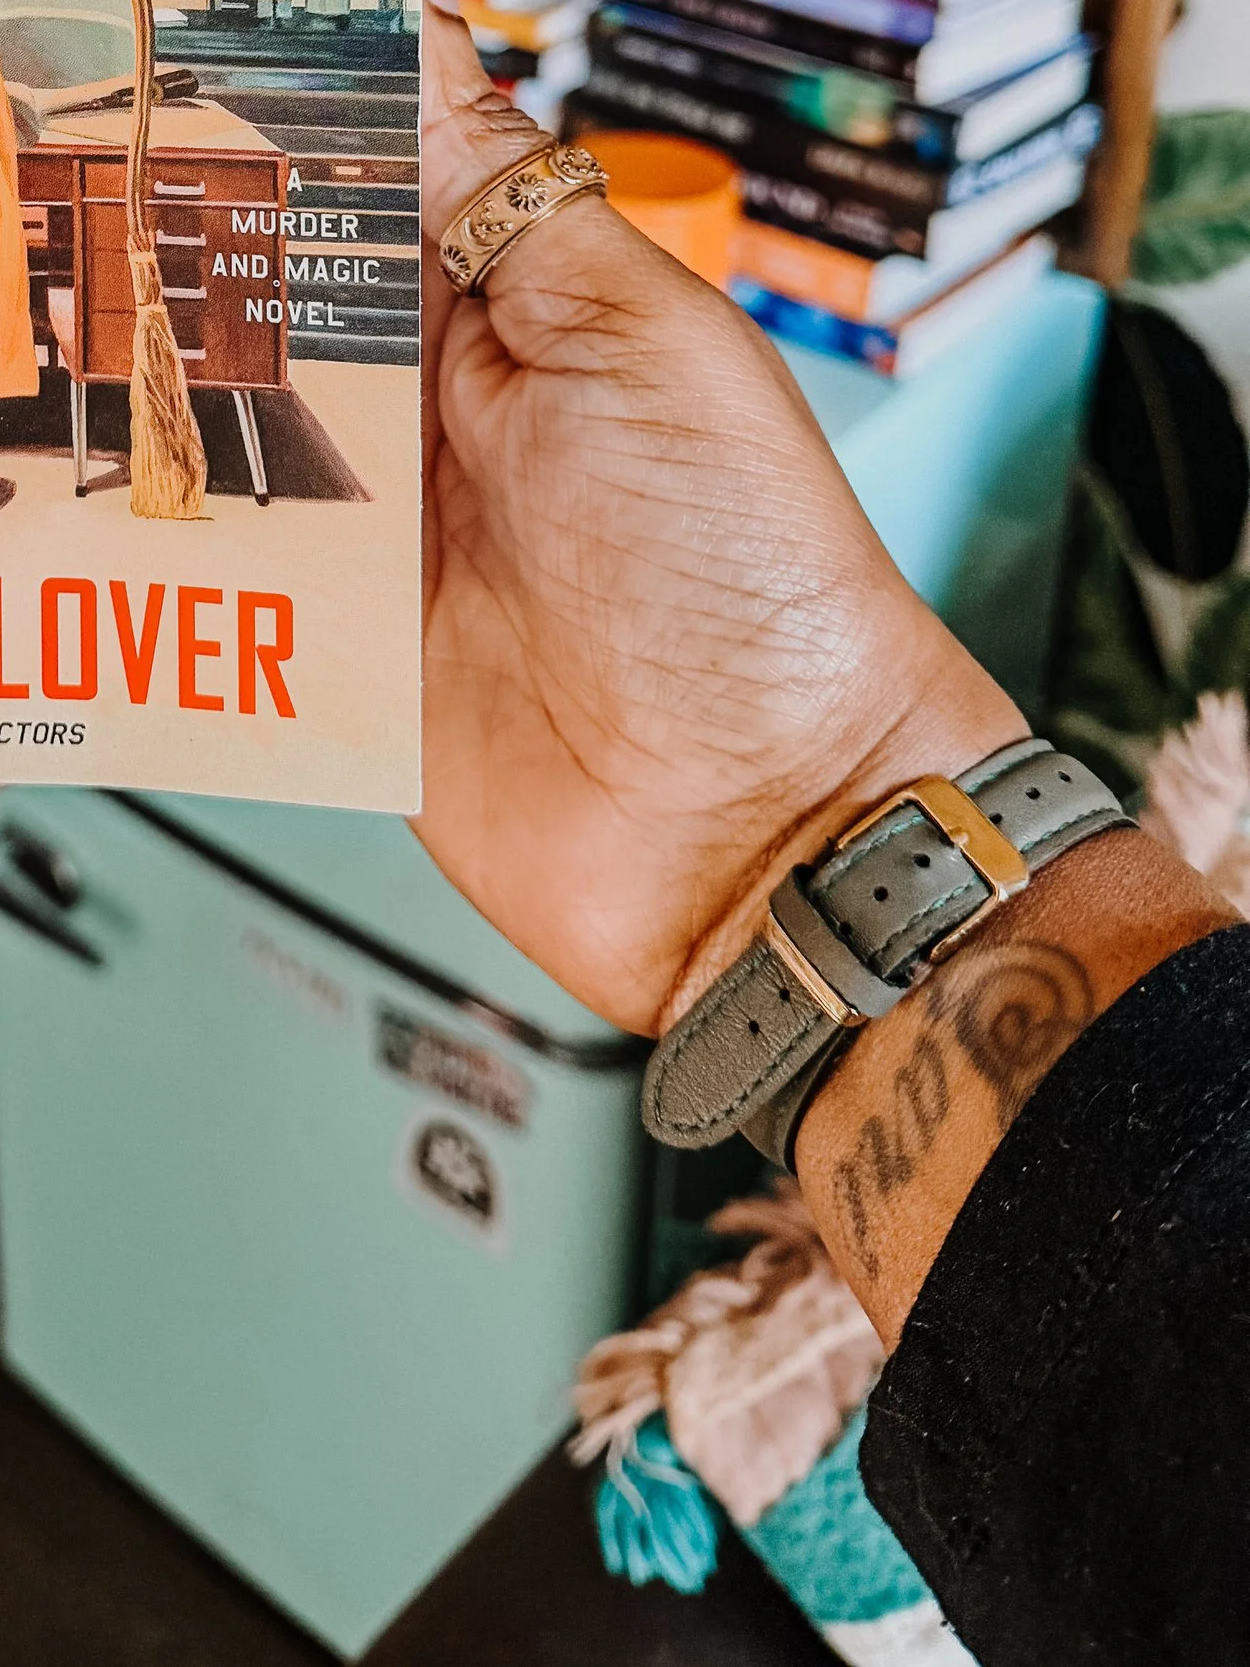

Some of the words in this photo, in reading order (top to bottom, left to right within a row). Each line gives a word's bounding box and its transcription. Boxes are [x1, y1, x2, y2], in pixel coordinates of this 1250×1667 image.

[286, 167, 303, 192] A
[231, 208, 359, 239] MURDER
[211, 252, 269, 280] AND
[284, 255, 382, 284] MAGIC
[245, 297, 345, 327] NOVEL
